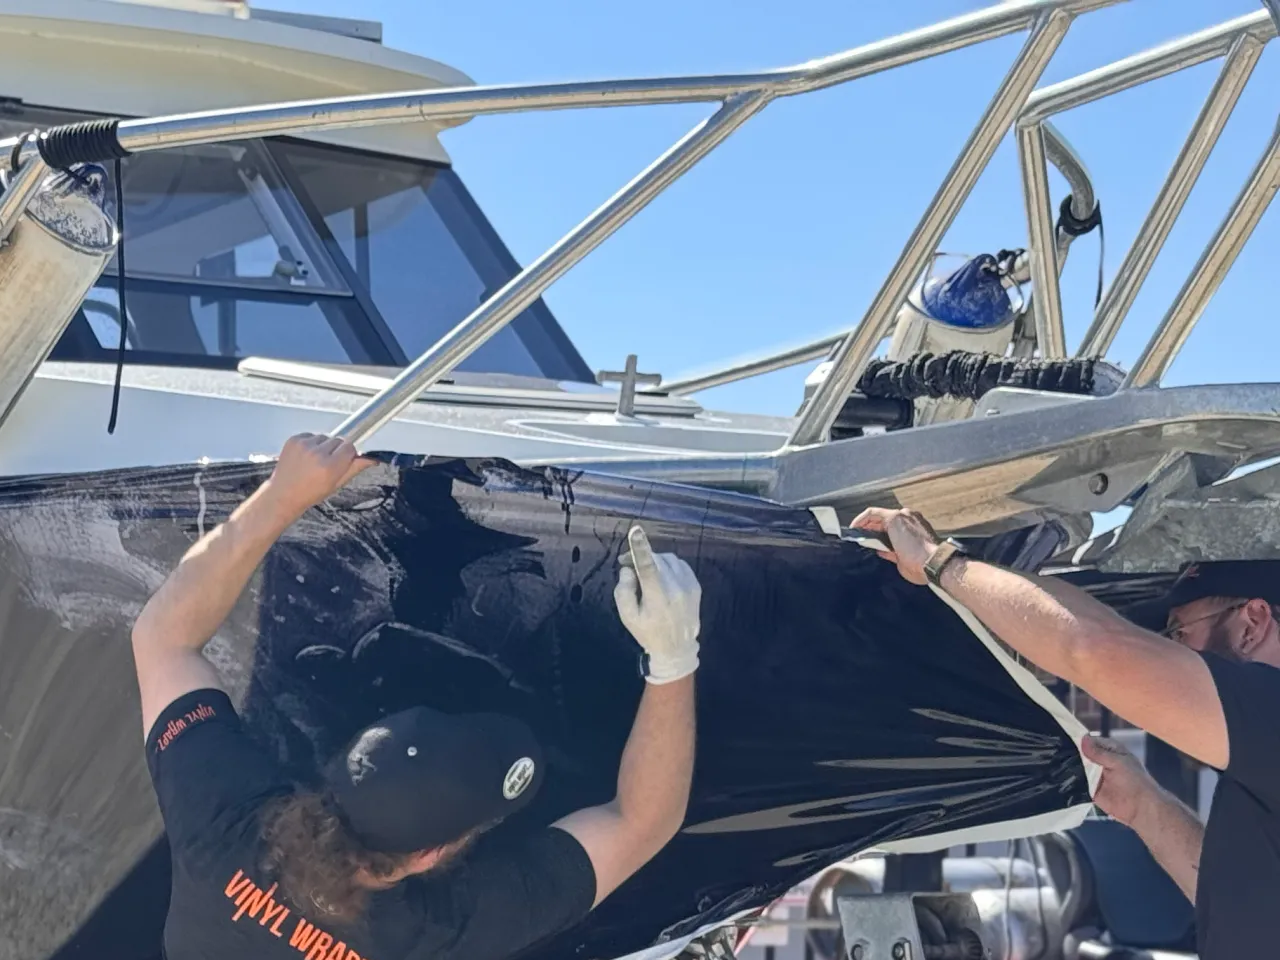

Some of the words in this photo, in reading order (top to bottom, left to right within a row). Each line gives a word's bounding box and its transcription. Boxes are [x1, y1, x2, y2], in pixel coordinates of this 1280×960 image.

[184, 703, 216, 723] VINYL
[155, 718, 188, 753] WRAPZ
[224, 868, 291, 938] VINYL
